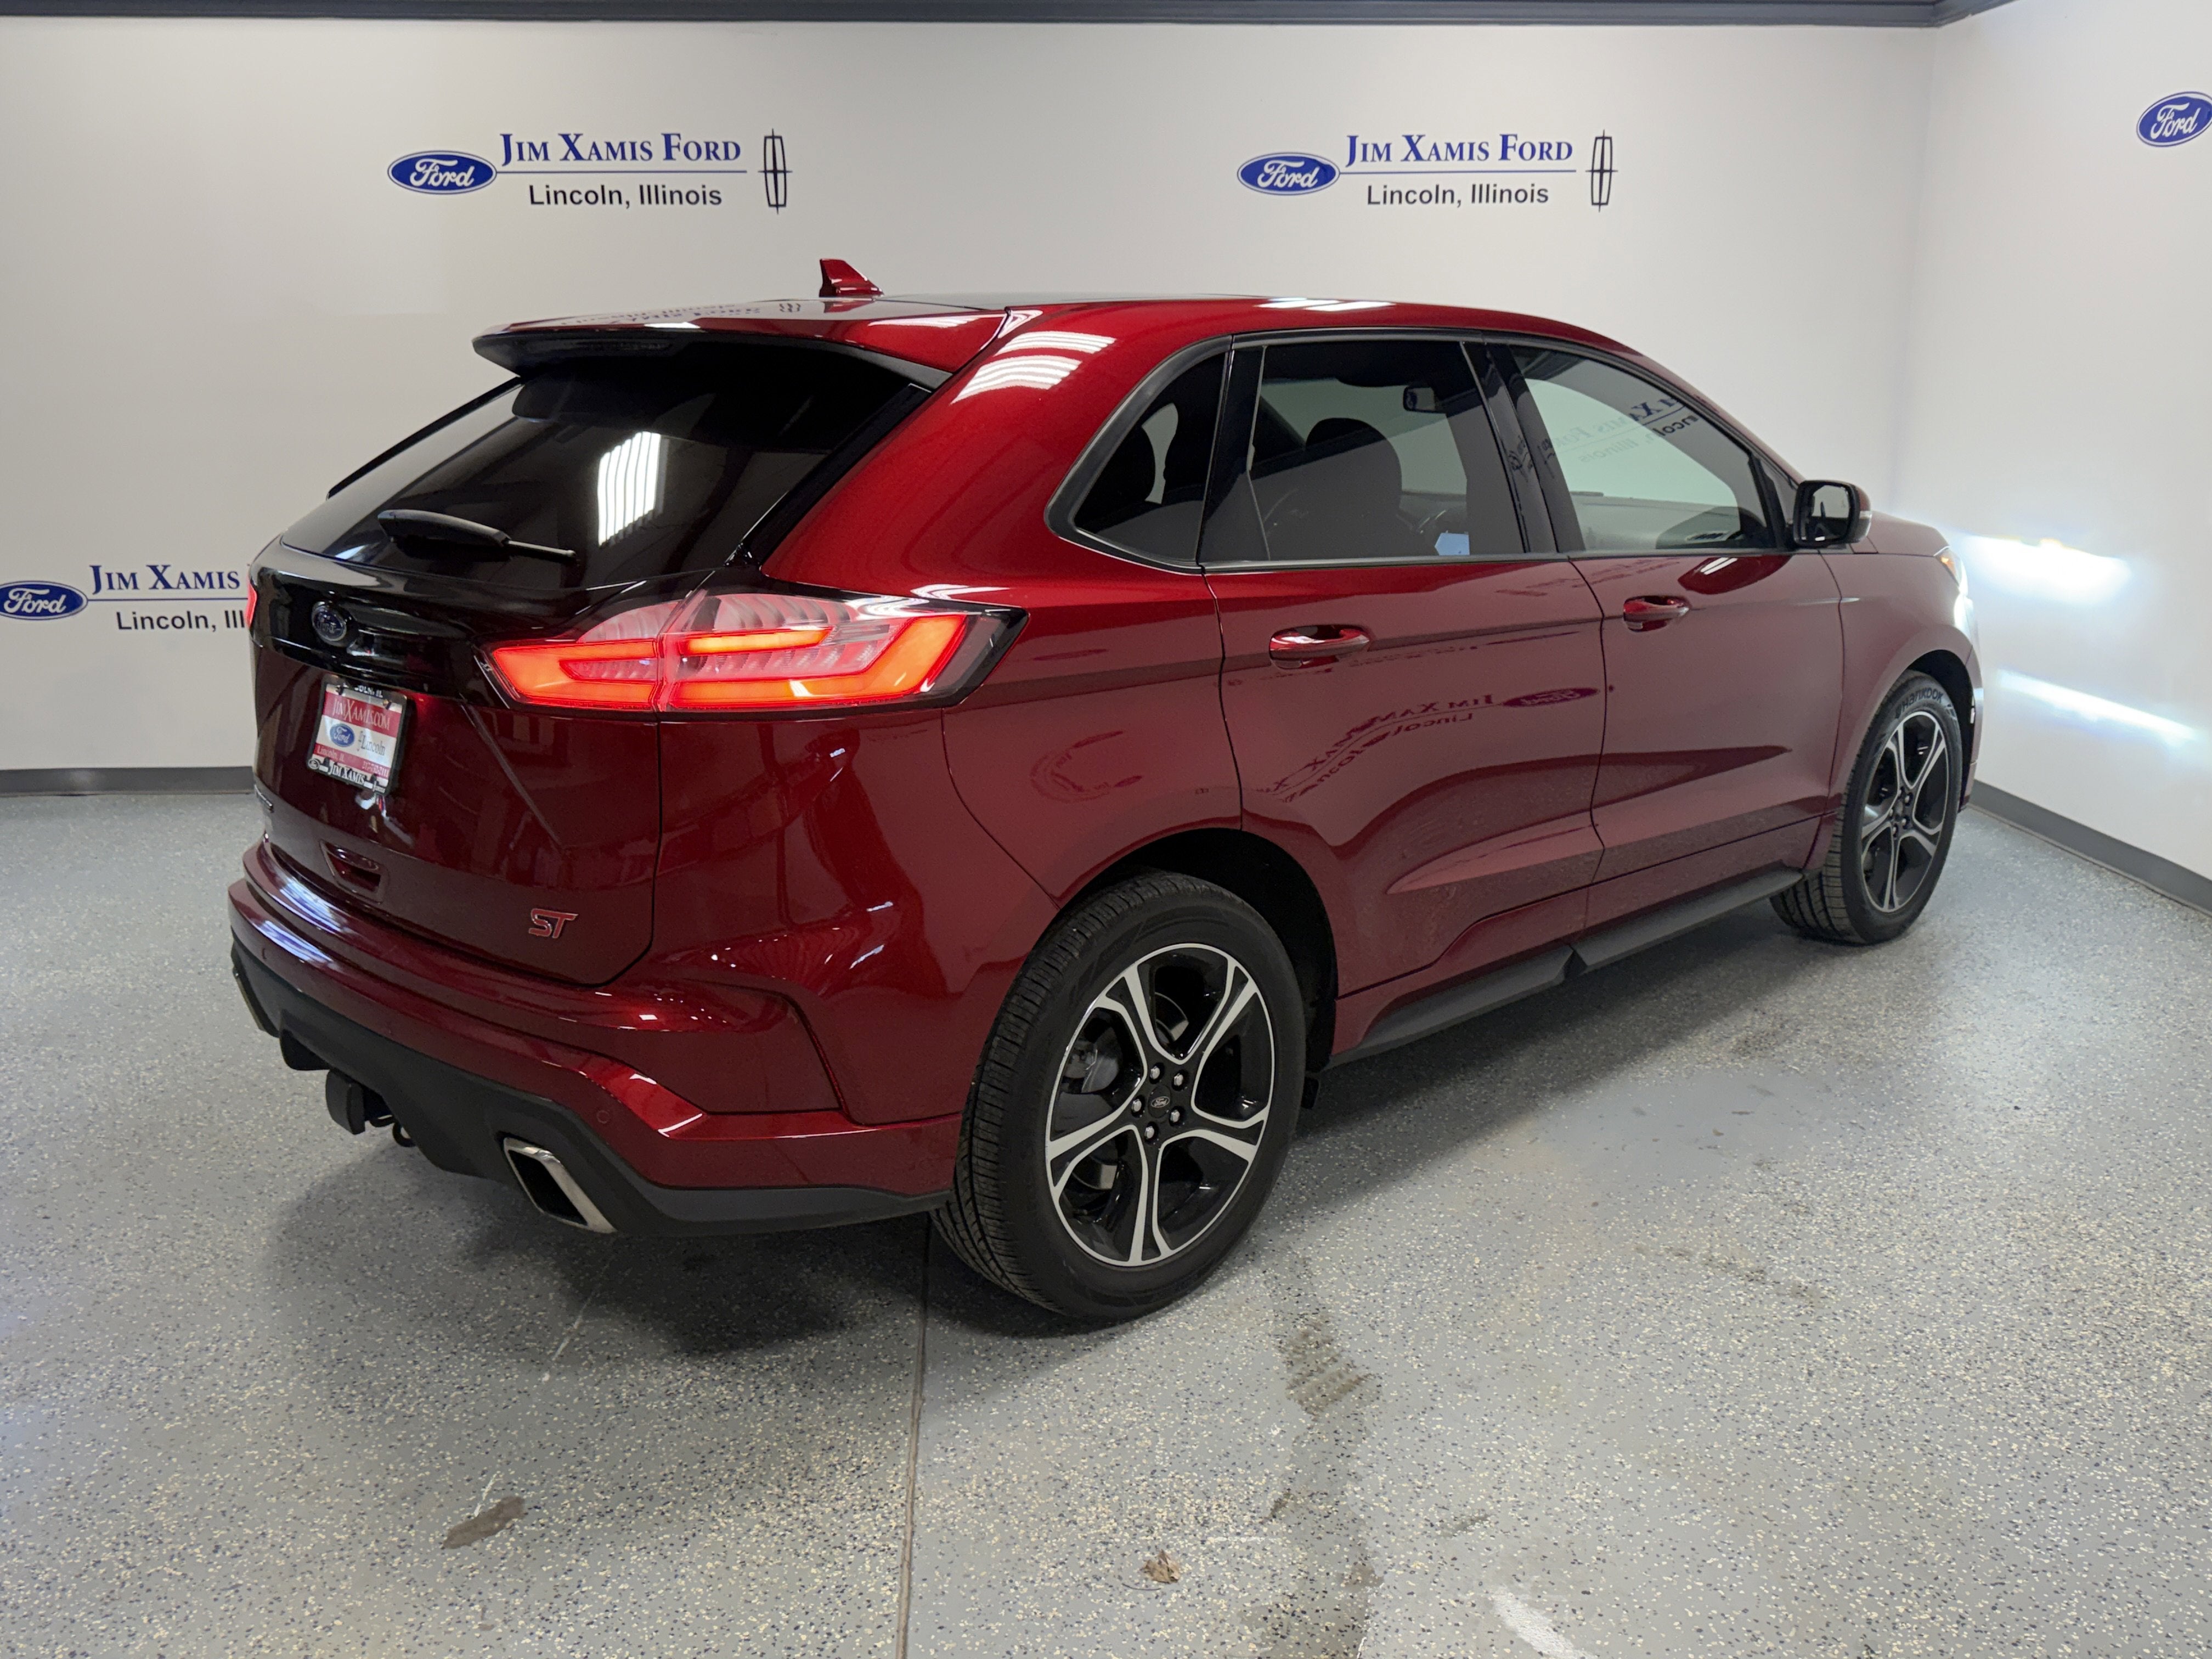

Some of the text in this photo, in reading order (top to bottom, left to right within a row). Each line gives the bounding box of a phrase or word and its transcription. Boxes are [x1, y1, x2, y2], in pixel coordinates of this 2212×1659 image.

[2151, 102, 2202, 139] Ford
[500, 133, 741, 166] JIM XAMIS FORD
[1346, 134, 1573, 167] JIM XAMIS FORD
[410, 158, 475, 188] Ford
[1257, 160, 1319, 189] Ford
[529, 184, 723, 209] Lincoln, Illinois
[1367, 183, 1549, 207] Lincoln, Illinois
[89, 565, 240, 595] JIM XAMIS
[3, 587, 67, 613] Ford
[116, 611, 216, 632] Lincoln,
[333, 727, 351, 744] Ford
[361, 732, 386, 756] Lincoln
[528, 909, 579, 939] ST
